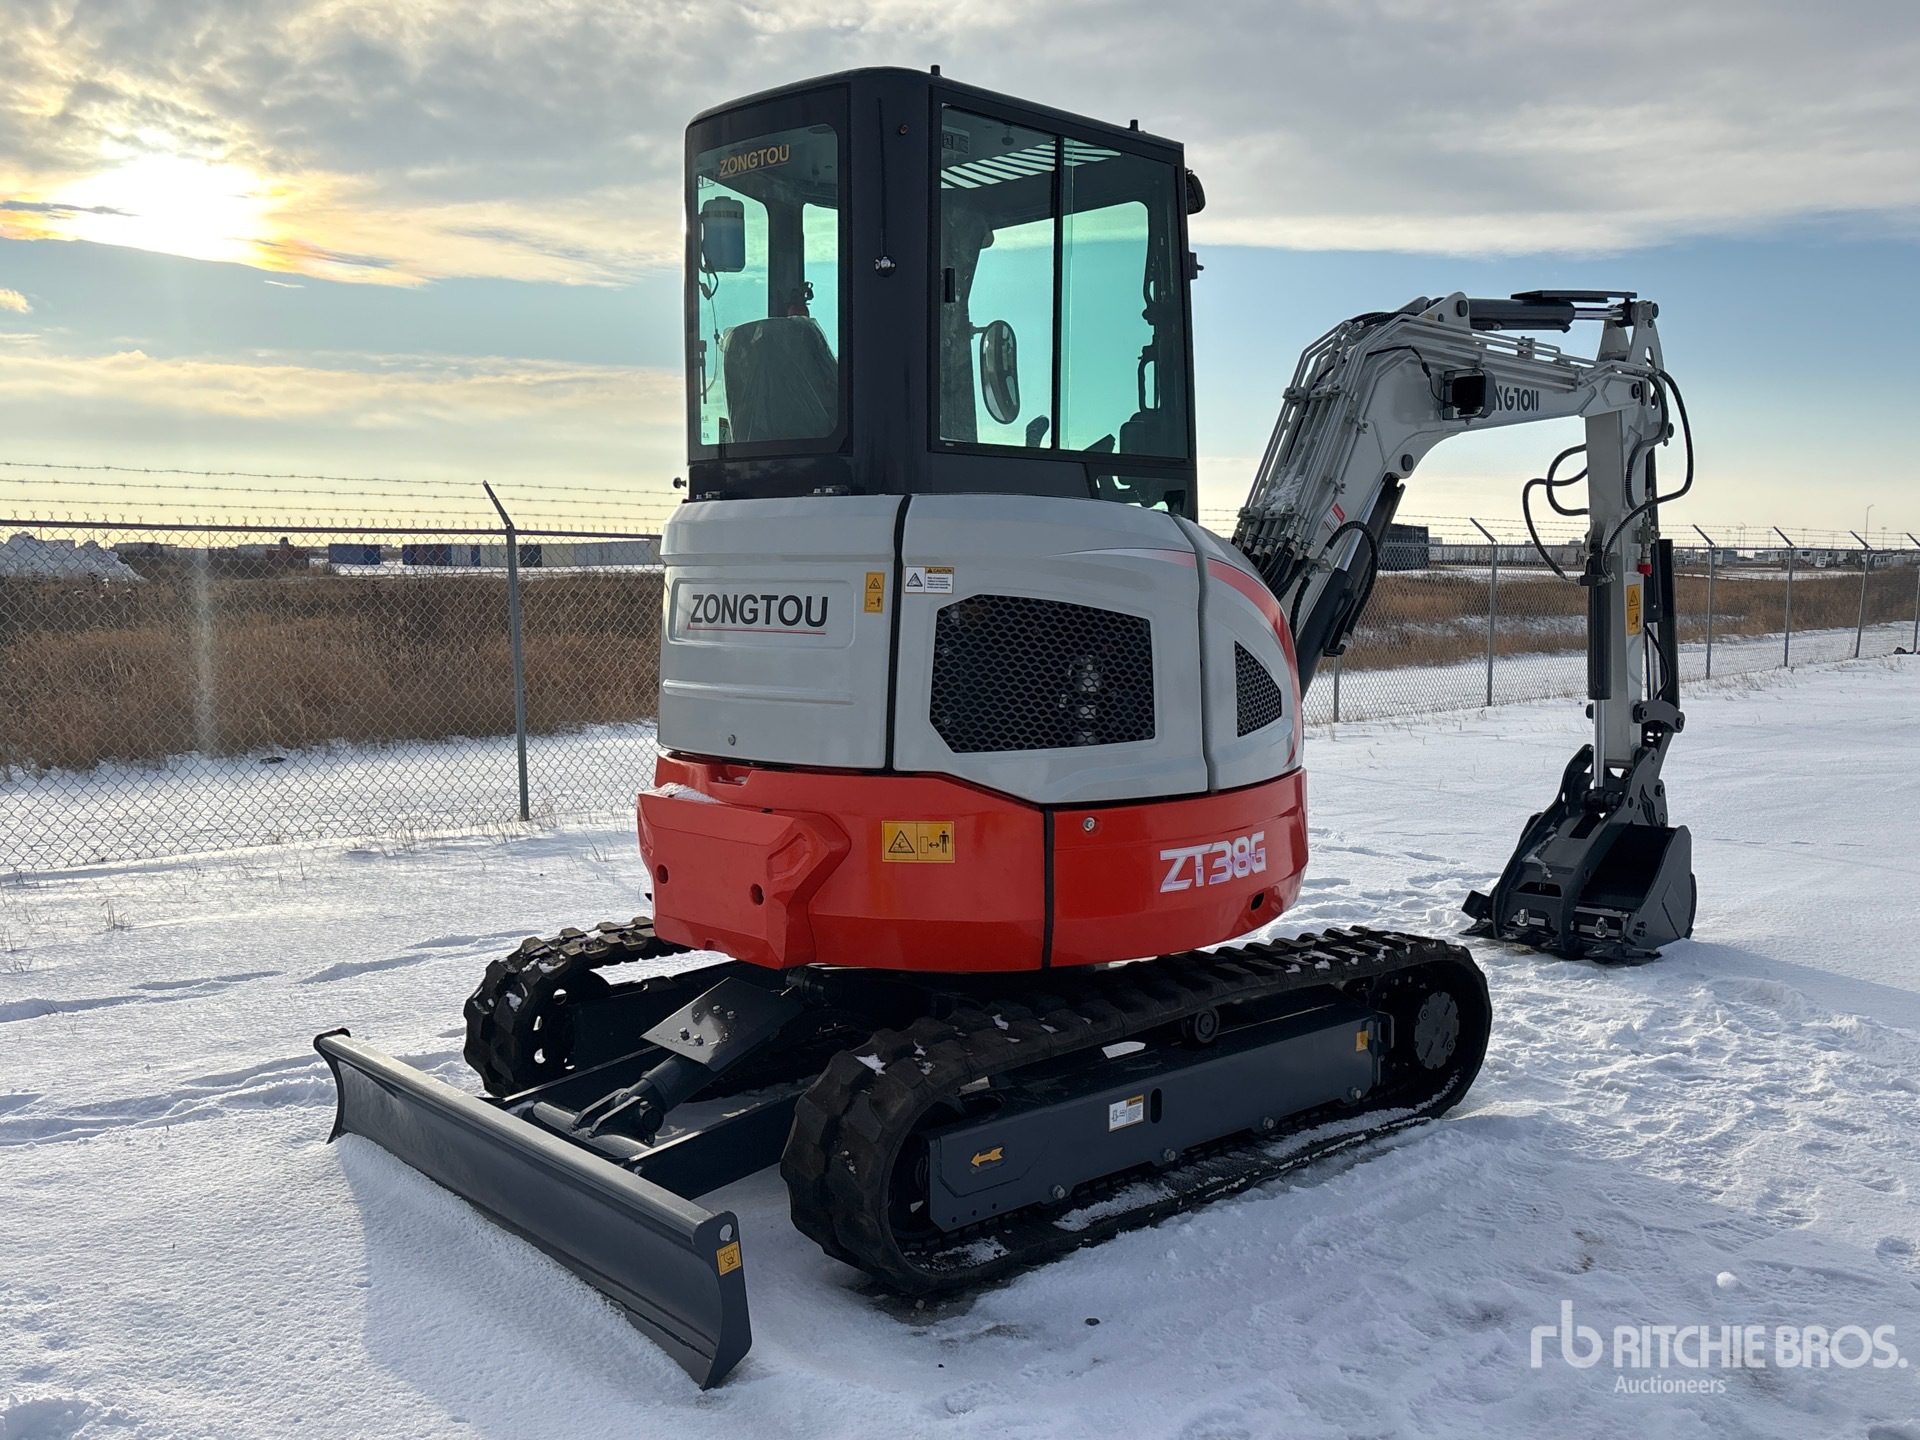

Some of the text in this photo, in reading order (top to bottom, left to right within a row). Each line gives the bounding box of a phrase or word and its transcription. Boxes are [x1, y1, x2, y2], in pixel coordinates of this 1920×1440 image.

[720, 144, 790, 177] ZONGTOU
[1494, 385, 1540, 412] NGTOU
[690, 593, 829, 628] ZONGTOU
[1160, 830, 1267, 893] ZT38G
